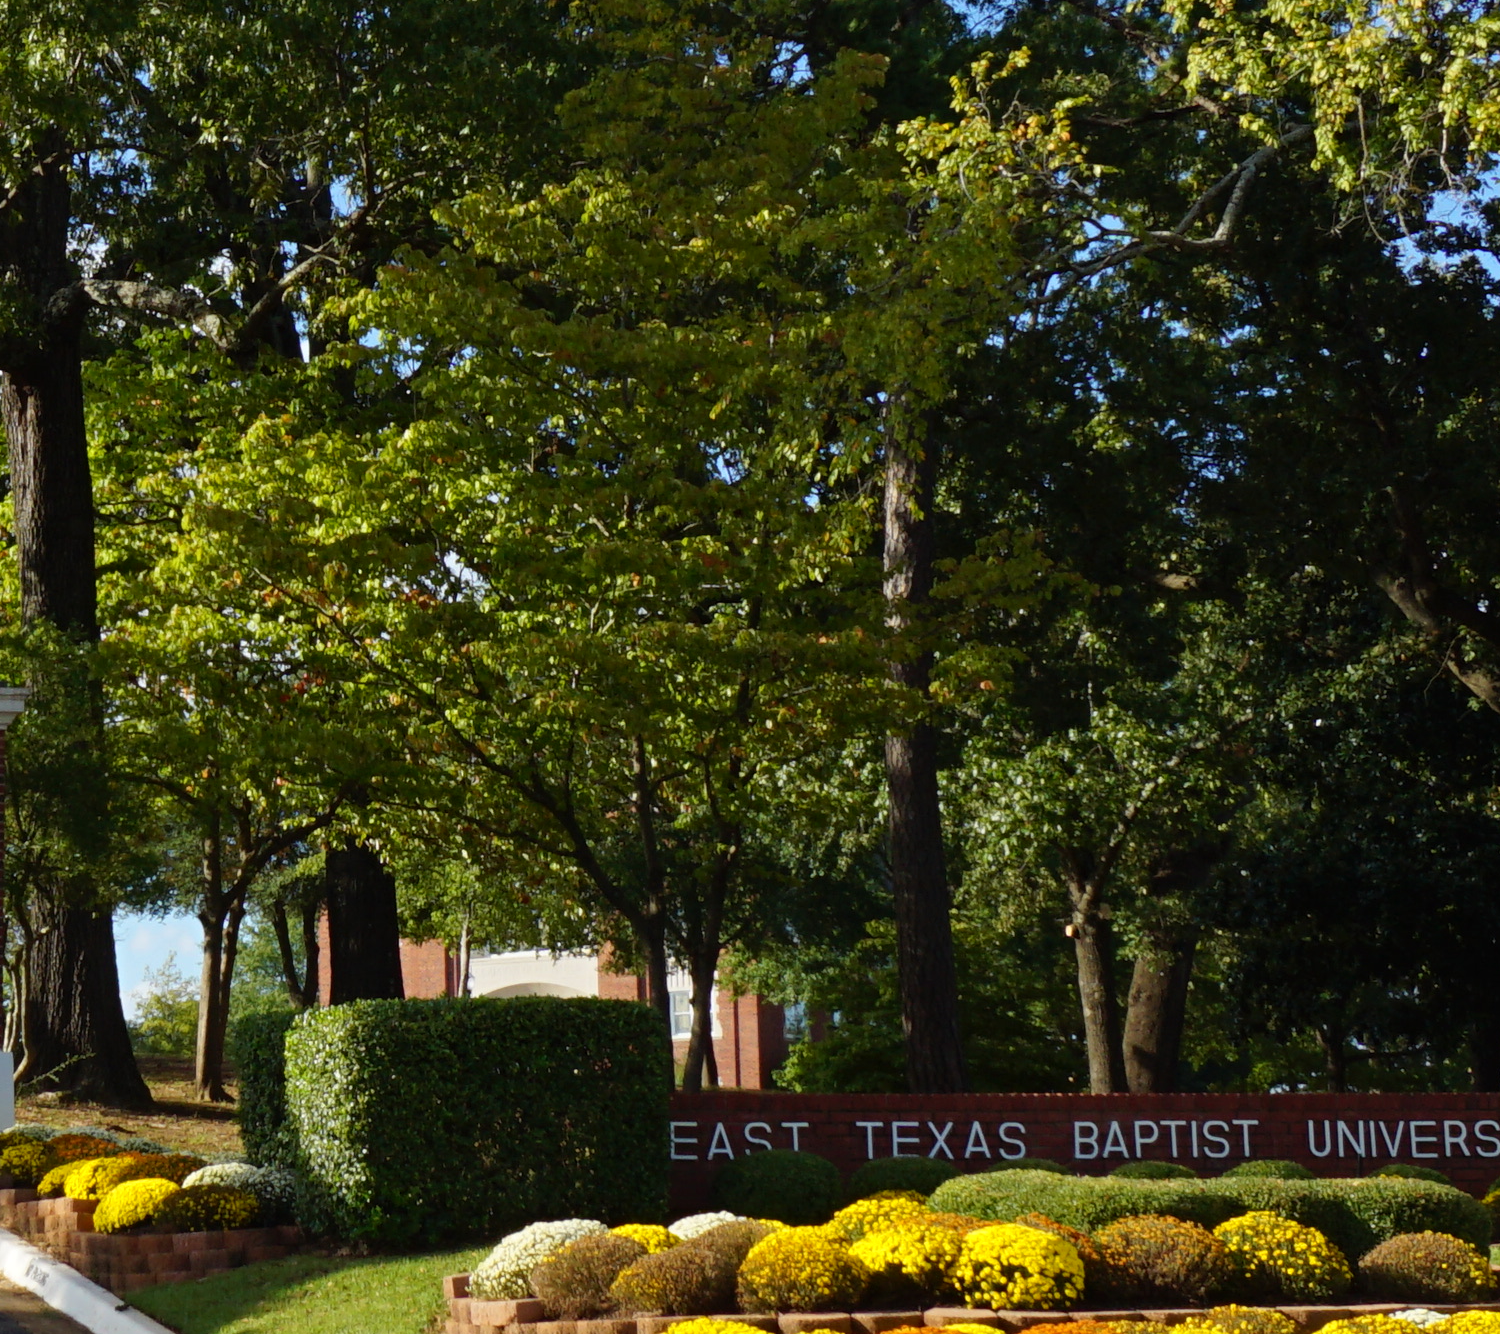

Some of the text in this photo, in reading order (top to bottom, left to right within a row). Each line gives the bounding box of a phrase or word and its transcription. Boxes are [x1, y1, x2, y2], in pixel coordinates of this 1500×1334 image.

[669, 1121, 809, 1161] EAST
[855, 1120, 1027, 1160] TEXAS
[1074, 1119, 1259, 1159] BAPTIST
